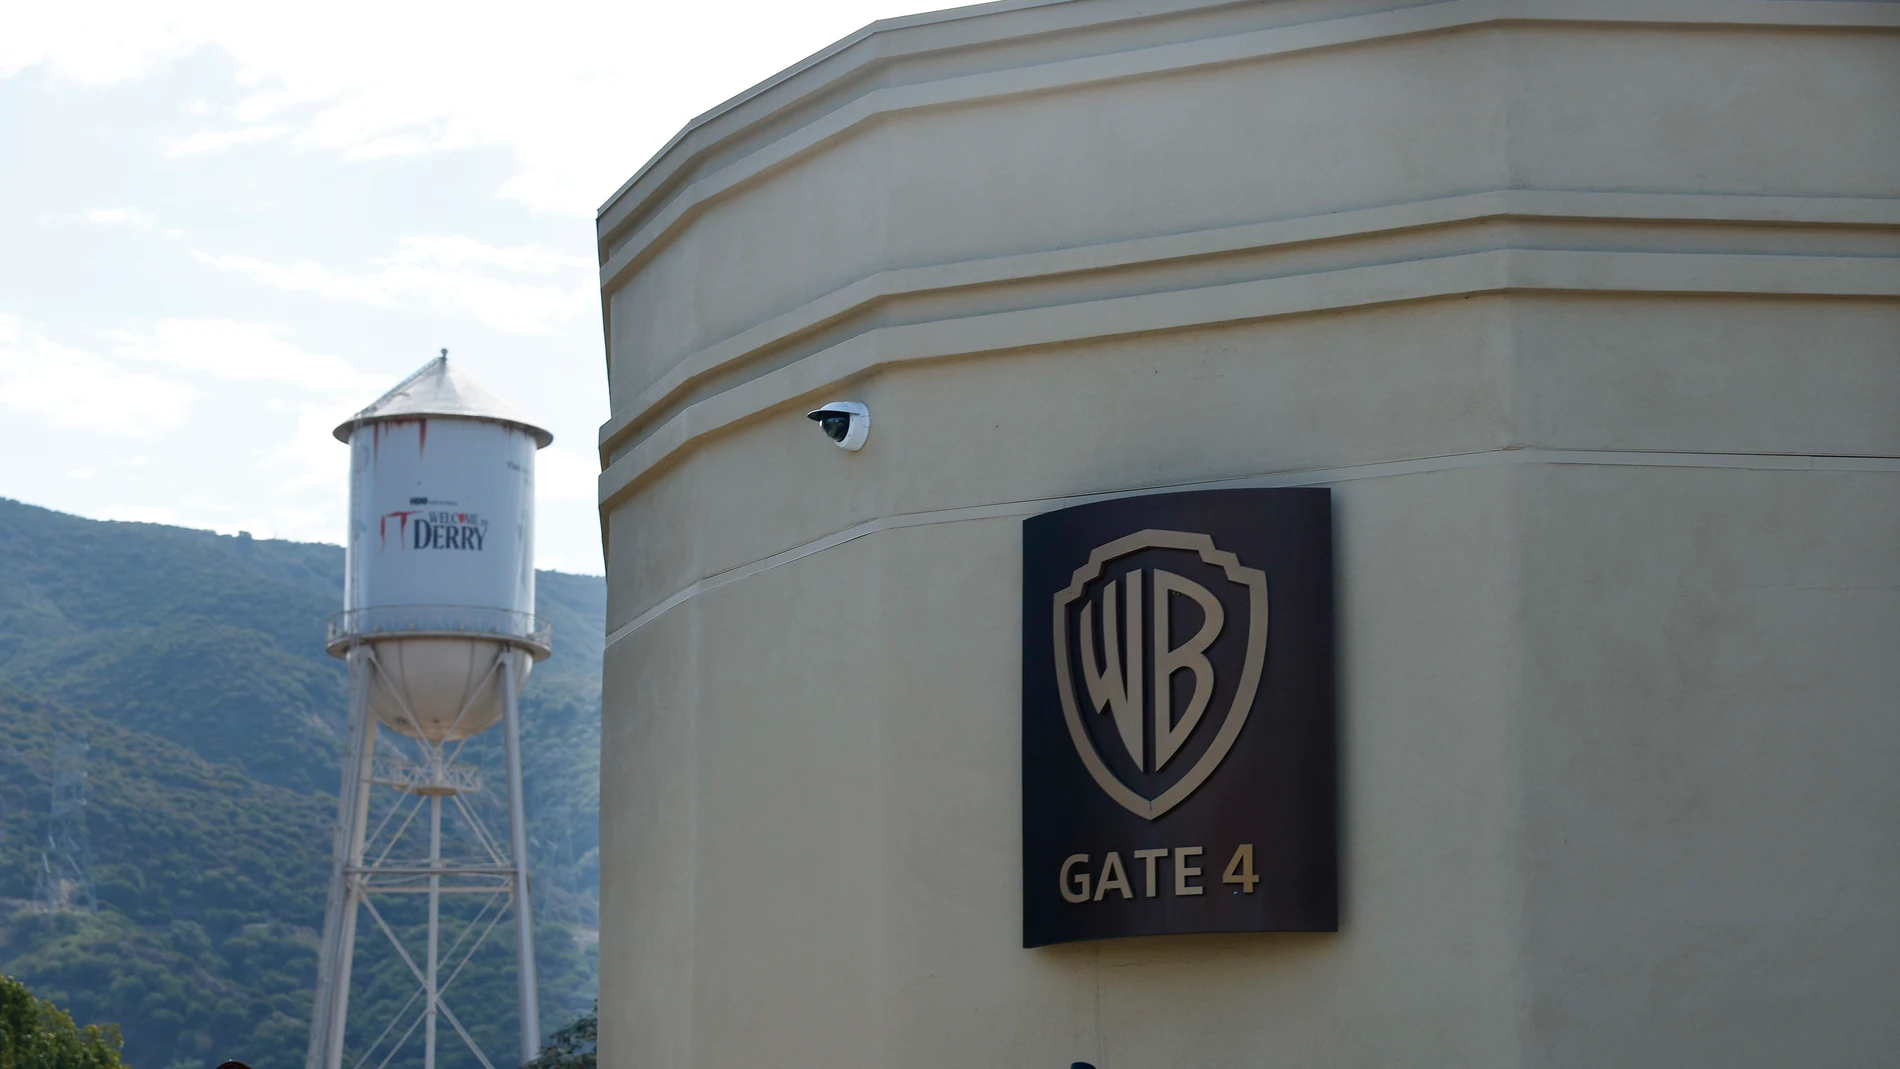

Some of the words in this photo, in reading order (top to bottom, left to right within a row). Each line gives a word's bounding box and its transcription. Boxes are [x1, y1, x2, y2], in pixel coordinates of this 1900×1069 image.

[380, 510, 421, 553] IT
[414, 519, 488, 551] DERRY
[1080, 568, 1224, 772] WB
[1059, 846, 1203, 904] GATE
[1222, 843, 1260, 894] 4
